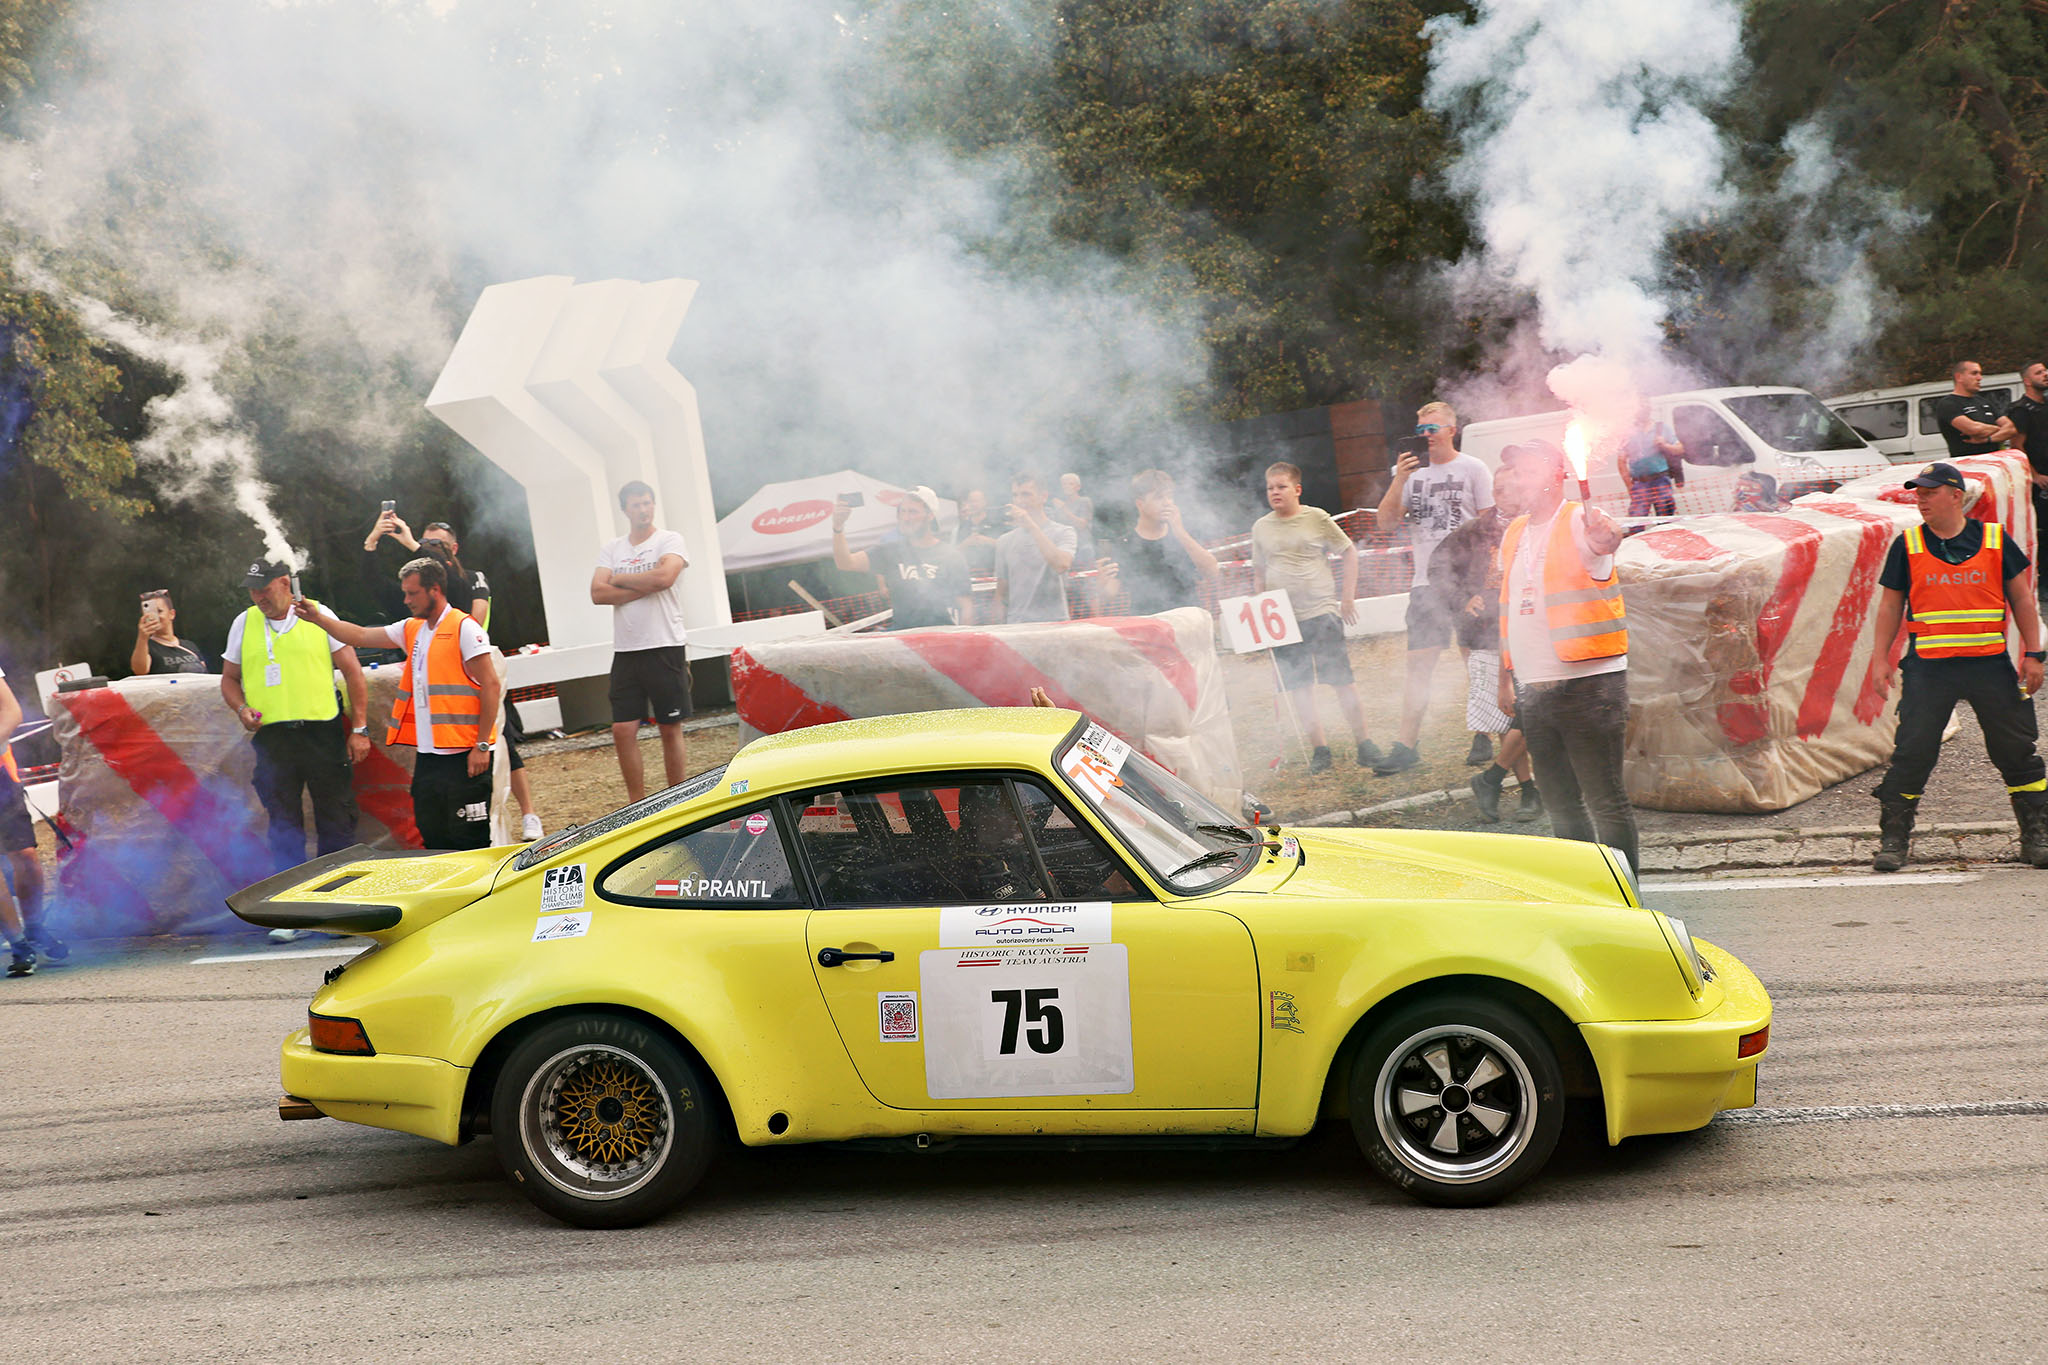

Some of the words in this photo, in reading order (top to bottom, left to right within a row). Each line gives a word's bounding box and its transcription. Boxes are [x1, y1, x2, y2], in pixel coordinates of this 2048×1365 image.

[758, 509, 827, 527] LAPREMA
[1926, 569, 1987, 586] HASIČI
[1239, 598, 1287, 645] 16
[1067, 755, 1124, 800] 75
[543, 884, 583, 896] HISTORIC
[680, 880, 772, 898] R.PRANTL
[543, 895, 557, 903] HILL
[560, 892, 583, 901] CLIMB
[541, 899, 583, 910] CHAMPIONSHIP
[1006, 905, 1077, 915] HYUNDAI
[975, 928, 1023, 936] AUTO
[1028, 926, 1075, 935] POLA
[996, 937, 1036, 945] autorizovaný
[960, 949, 1014, 959] HISTORIC
[1018, 948, 1062, 956] RACING
[1005, 958, 1037, 966] TEAM
[1039, 956, 1087, 965] AUSTRIA
[991, 987, 1064, 1055] 75
